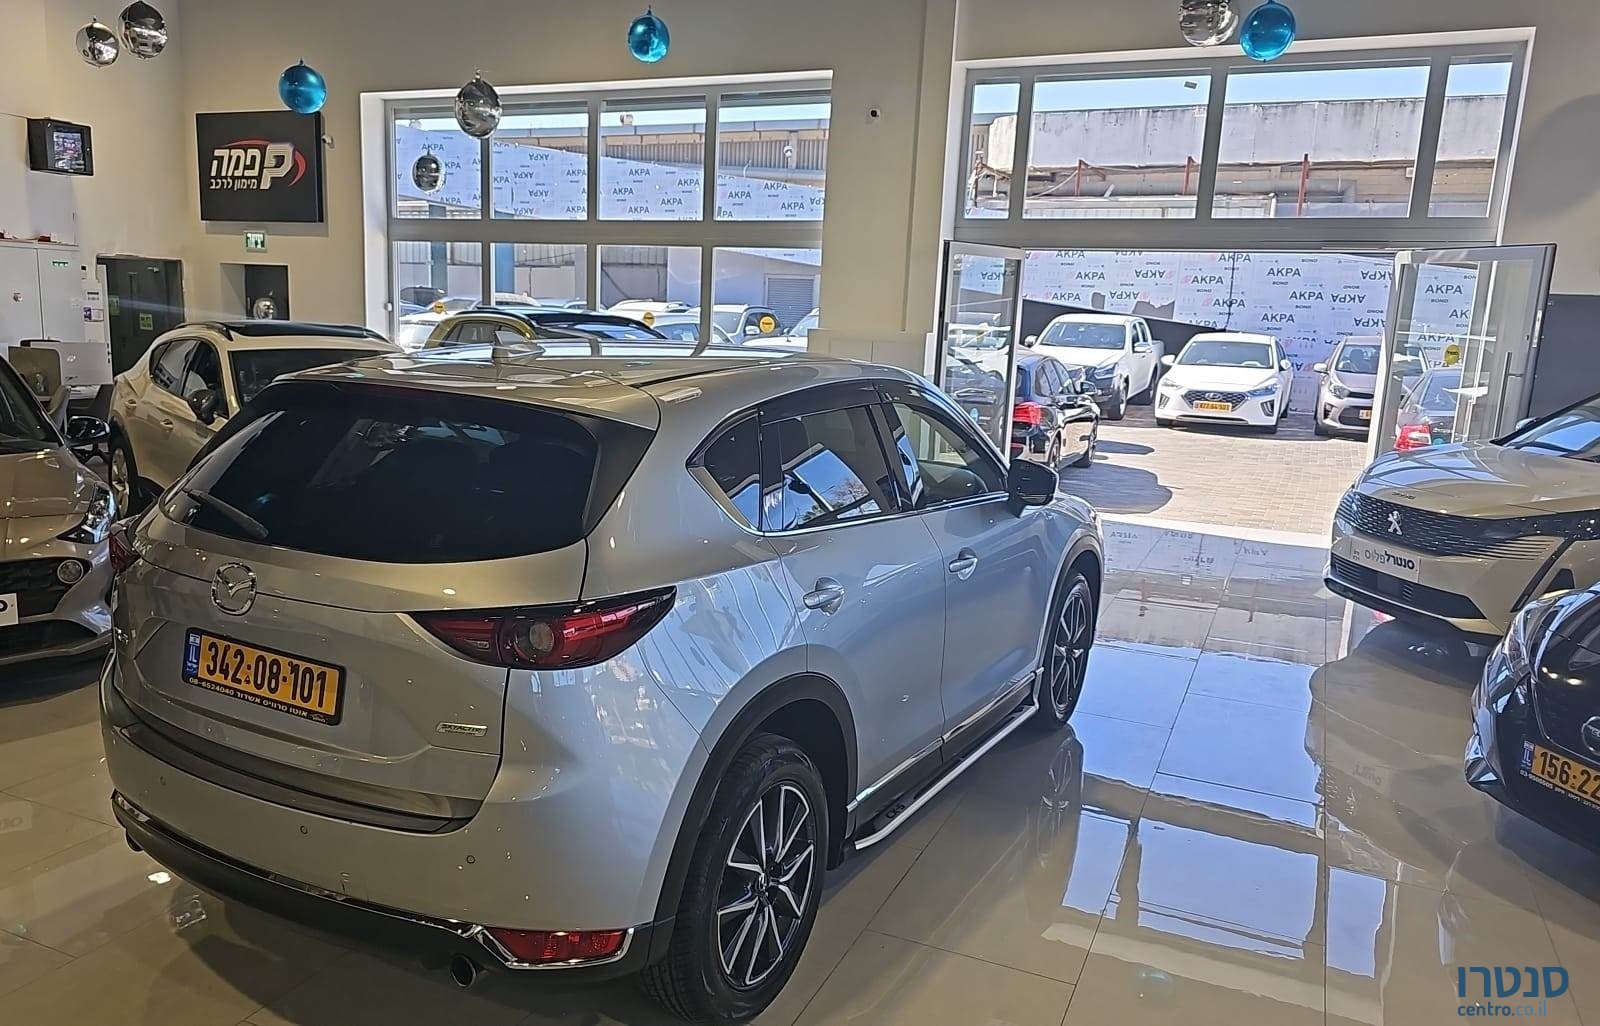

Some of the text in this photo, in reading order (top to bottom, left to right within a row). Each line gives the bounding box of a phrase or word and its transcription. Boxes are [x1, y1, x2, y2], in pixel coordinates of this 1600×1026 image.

[422, 143, 444, 152] AKPA
[210, 149, 261, 177] פמה
[444, 162, 461, 170] KPA
[566, 170, 587, 178] AKPA
[629, 169, 650, 177] AKPA
[210, 177, 257, 191] מימון לרכב
[494, 176, 509, 184] KPA
[678, 179, 699, 187] AKPA
[764, 183, 788, 191] AKPA
[613, 188, 634, 196] AKPA
[728, 192, 752, 200] AKPA
[440, 197, 462, 205] AKPA
[661, 199, 683, 207] AKPA
[566, 206, 587, 214] AKPA
[628, 206, 650, 214] AKPA
[781, 203, 805, 211] AKPA
[1056, 250, 1085, 259] AKPA
[1218, 254, 1252, 263] AKPA
[1075, 272, 1106, 281] AKPA
[1267, 268, 1301, 277] AKPA
[1191, 276, 1225, 285] AKPA
[1425, 285, 1463, 295] AKPA
[1052, 293, 1082, 301] AKPA
[1289, 291, 1324, 301] AKPA
[1213, 299, 1246, 308] AKPA
[1449, 309, 1470, 319] AK
[1261, 314, 1295, 323] AKPA
